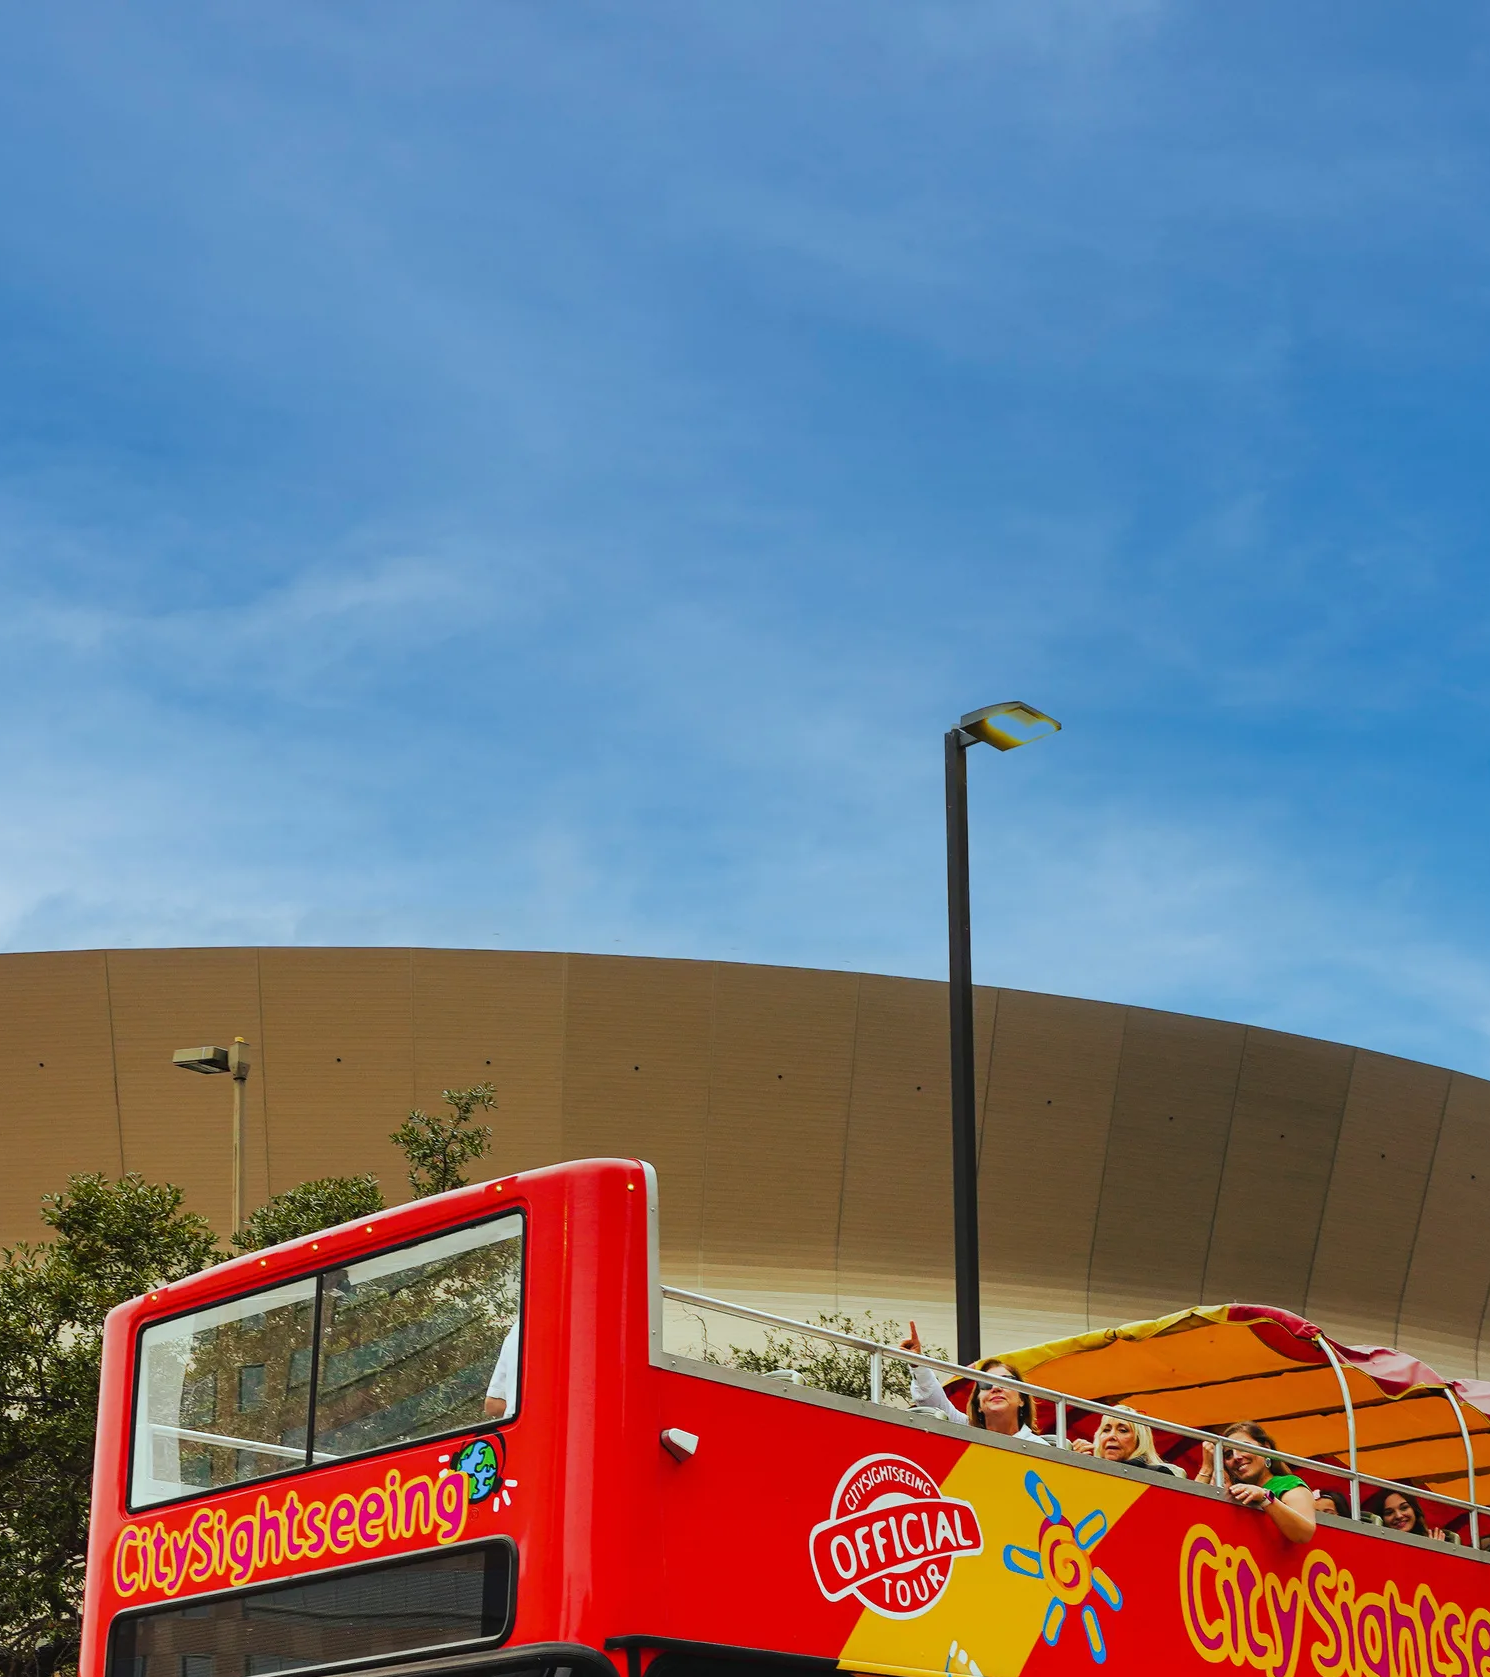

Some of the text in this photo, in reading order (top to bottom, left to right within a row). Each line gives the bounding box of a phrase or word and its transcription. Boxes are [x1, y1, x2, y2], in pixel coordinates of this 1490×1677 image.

[845, 1465, 931, 1511] CITYSIGHTSEEING
[113, 1468, 470, 1598] CitySightseeing
[830, 1510, 973, 1580] OFFICIAL
[881, 1563, 945, 1607] TOUR
